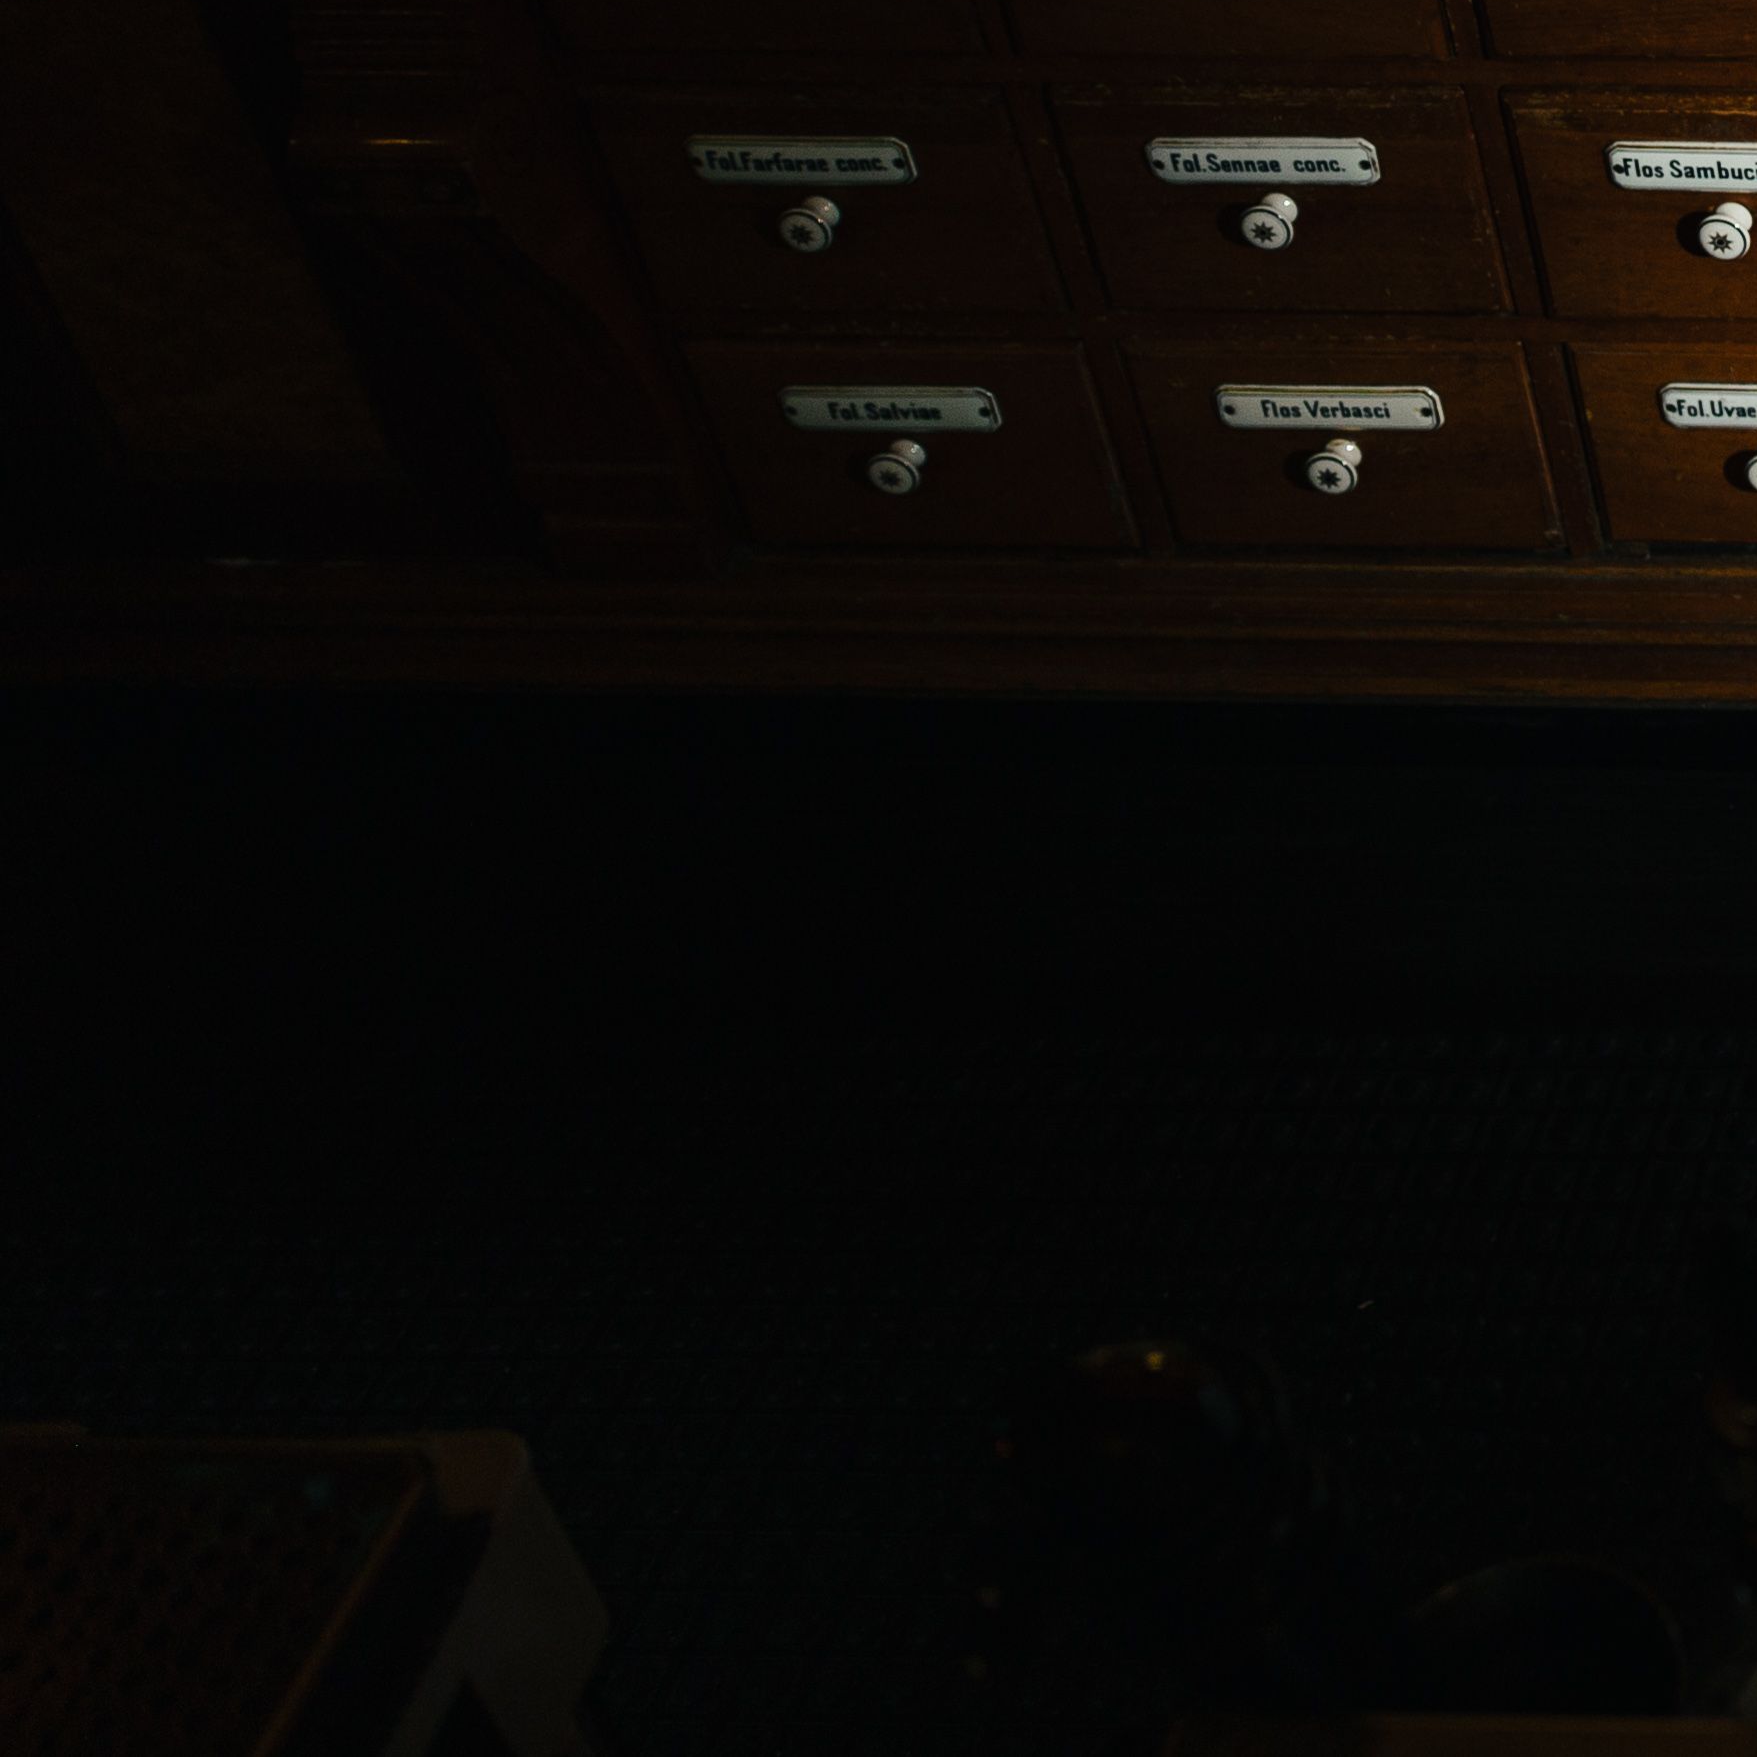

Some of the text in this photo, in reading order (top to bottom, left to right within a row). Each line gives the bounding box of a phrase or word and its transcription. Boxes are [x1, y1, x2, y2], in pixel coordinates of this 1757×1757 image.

[835, 154, 889, 175] conc.
[1293, 157, 1348, 176] conc.
[1622, 158, 1664, 179] Flos
[1261, 399, 1391, 421] Flos Verbasci
